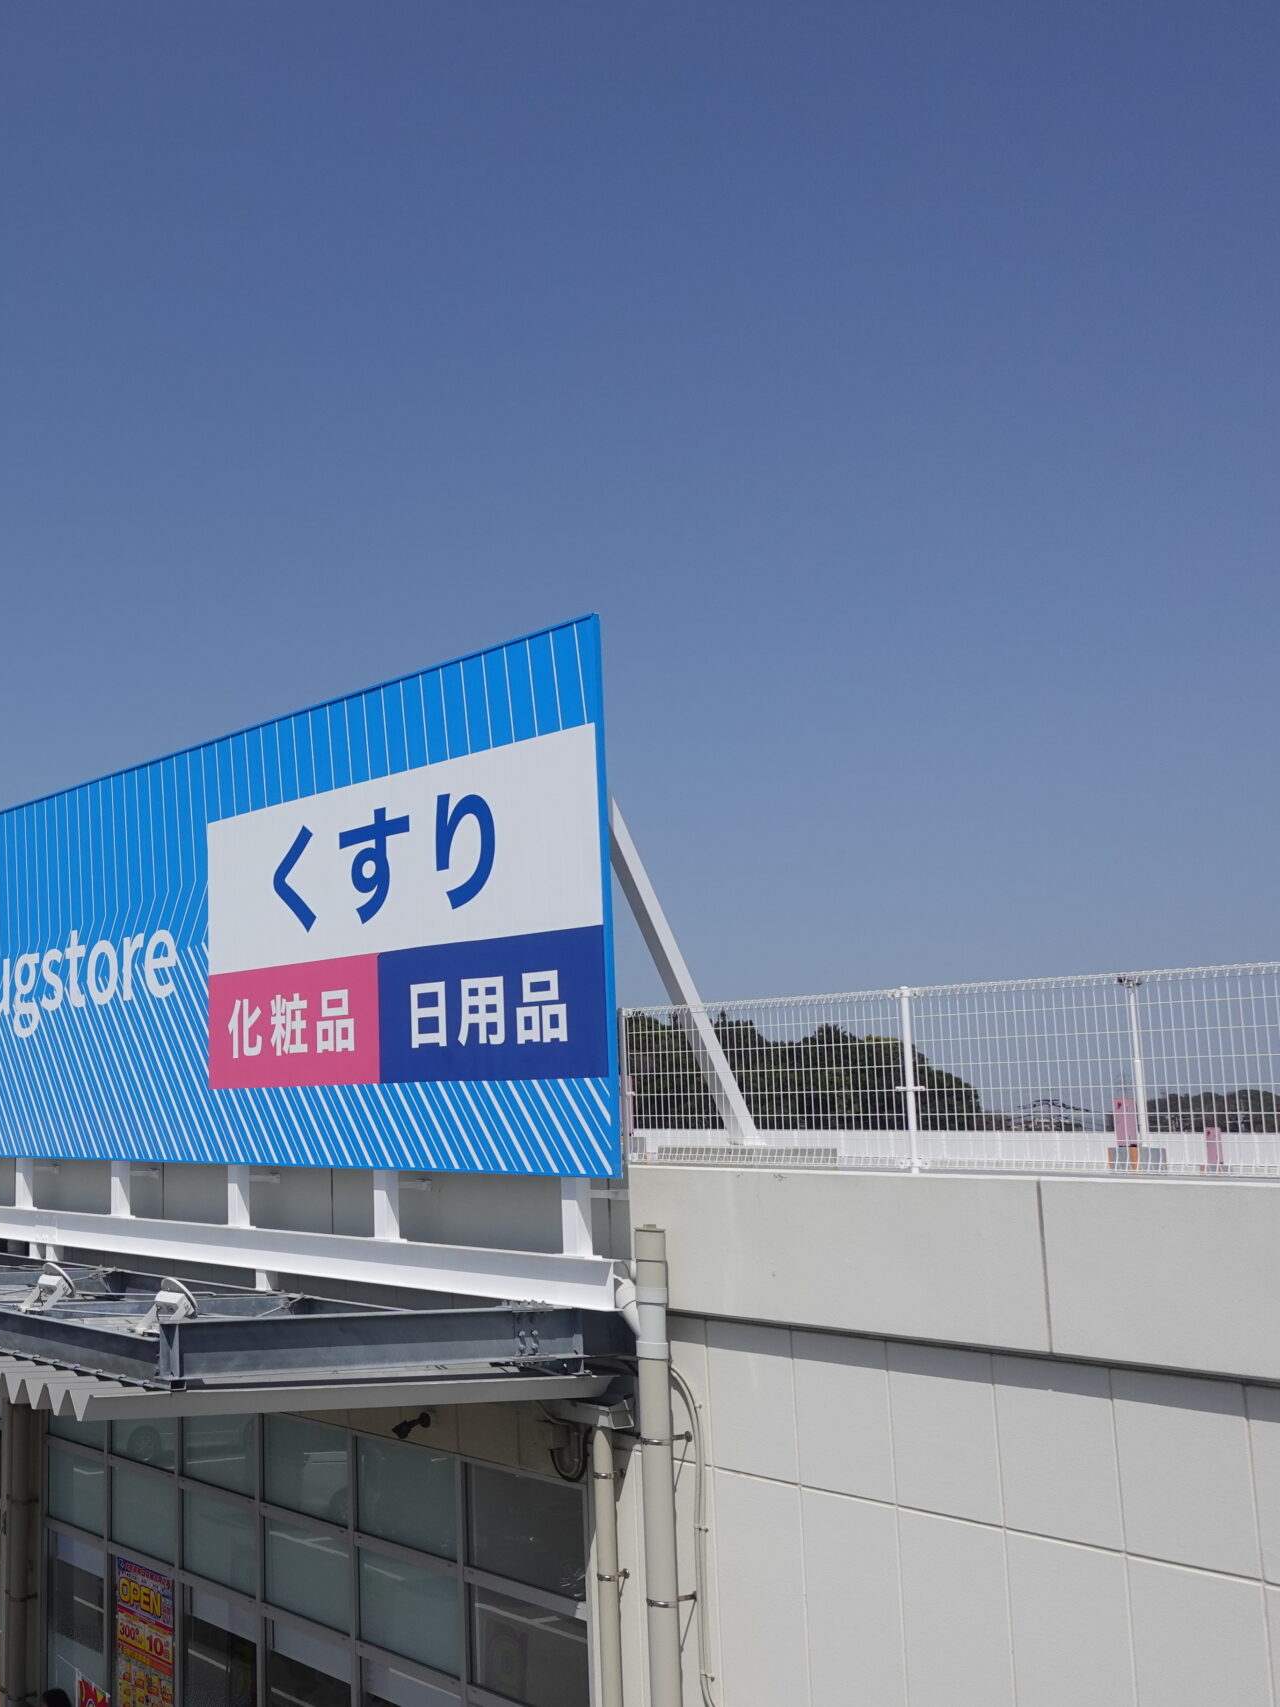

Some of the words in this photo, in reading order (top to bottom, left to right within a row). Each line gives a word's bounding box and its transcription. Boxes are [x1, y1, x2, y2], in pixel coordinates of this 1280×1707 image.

[272, 793, 496, 933] くすり
[228, 989, 355, 1058] 化粧品
[410, 970, 567, 1049] 日用品
[118, 1576, 162, 1619] OPEN
